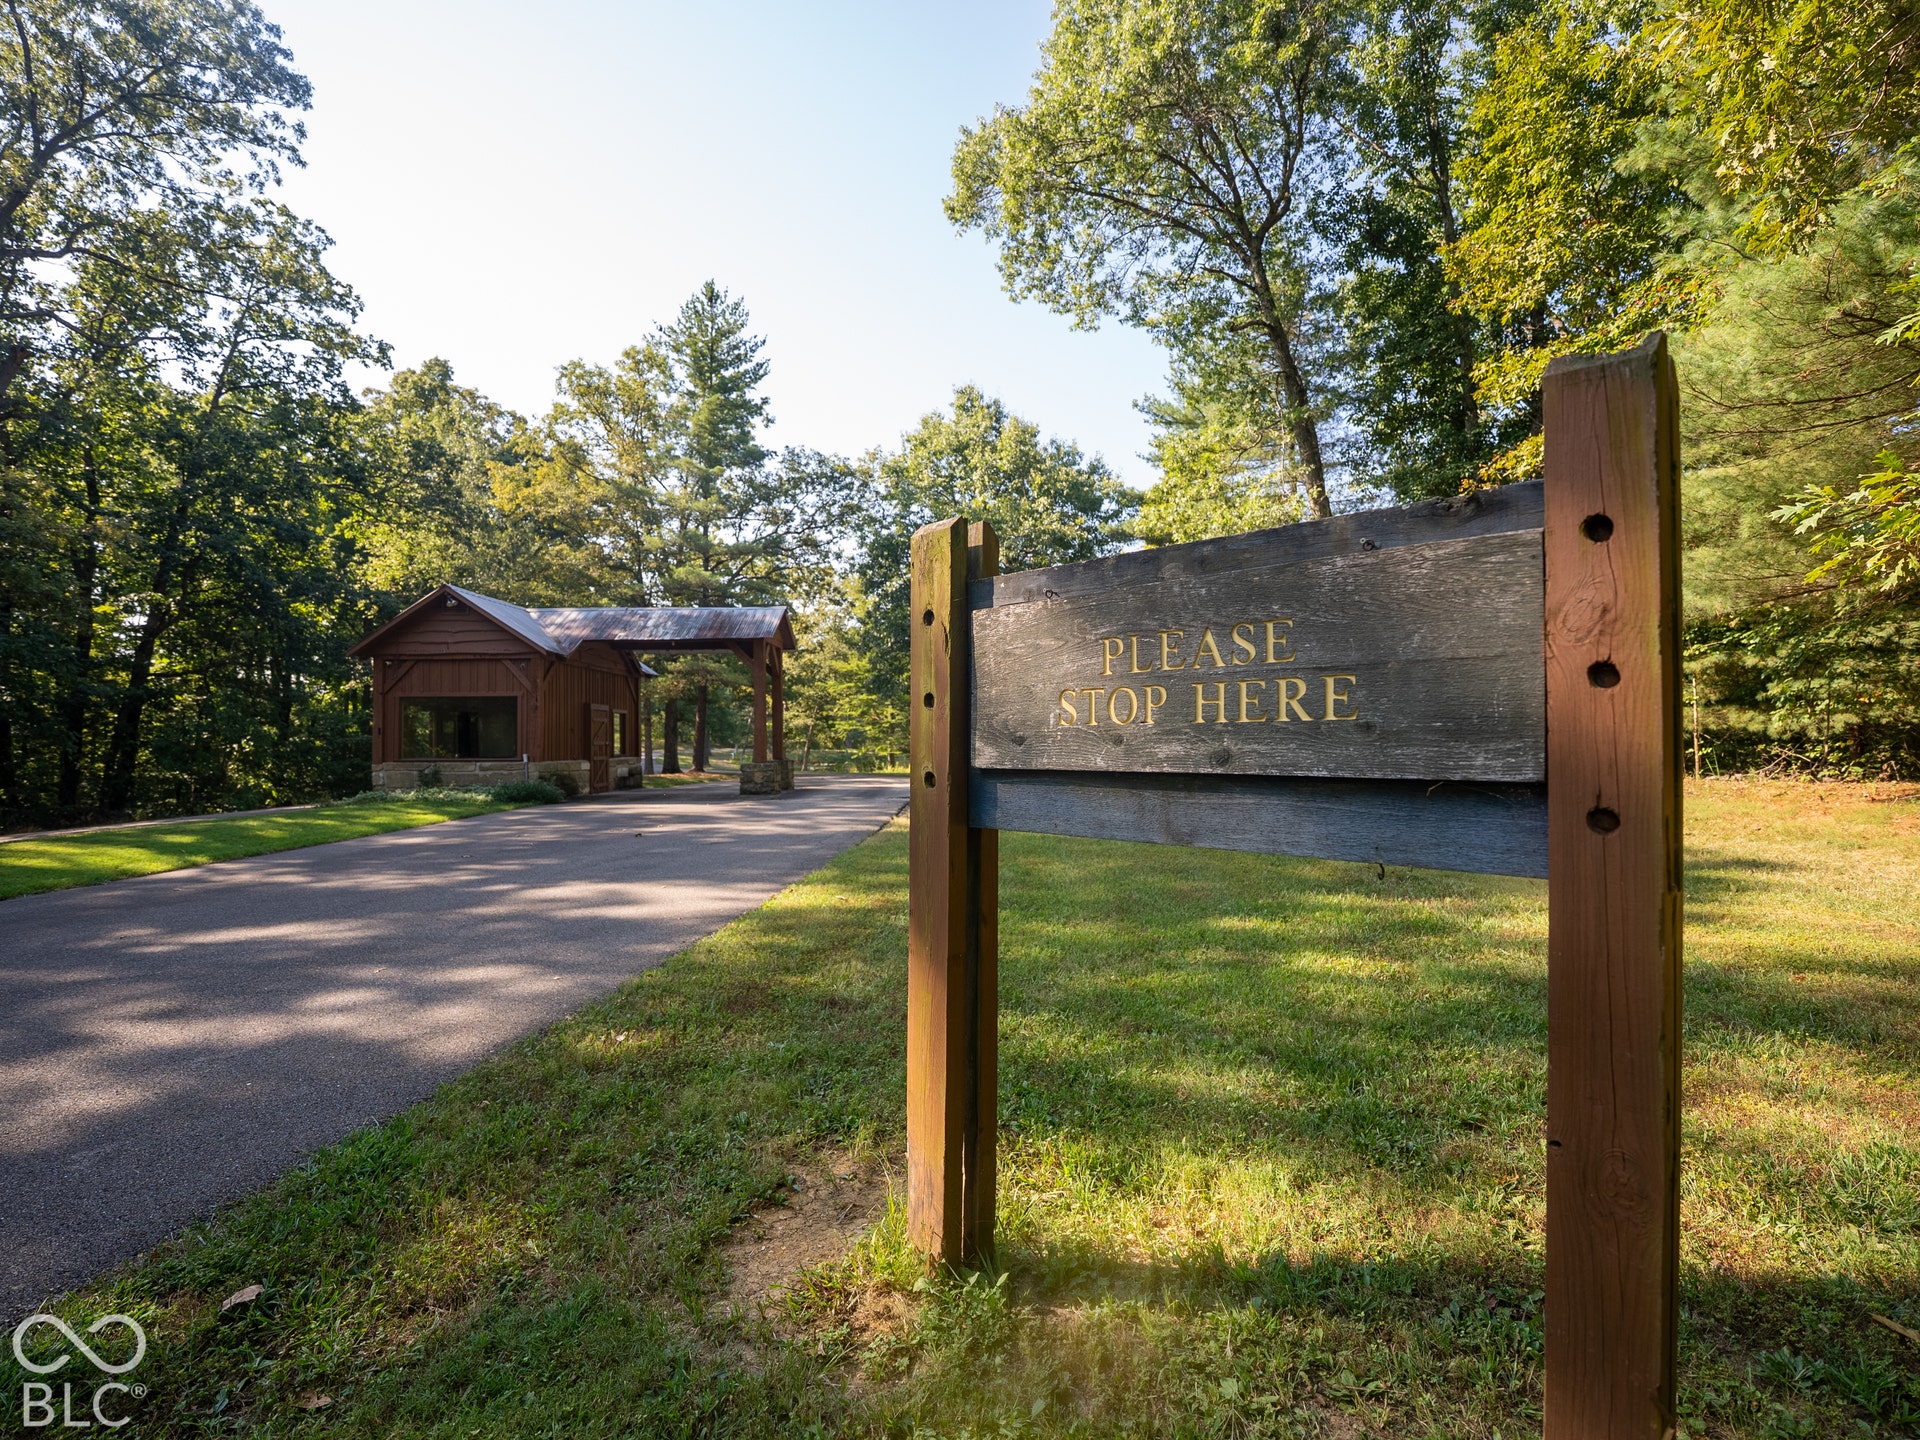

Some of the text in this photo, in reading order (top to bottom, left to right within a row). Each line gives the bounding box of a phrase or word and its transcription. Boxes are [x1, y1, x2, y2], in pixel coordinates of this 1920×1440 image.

[1101, 618, 1297, 676] PLEASE
[1058, 673, 1360, 726] STOP HERE
